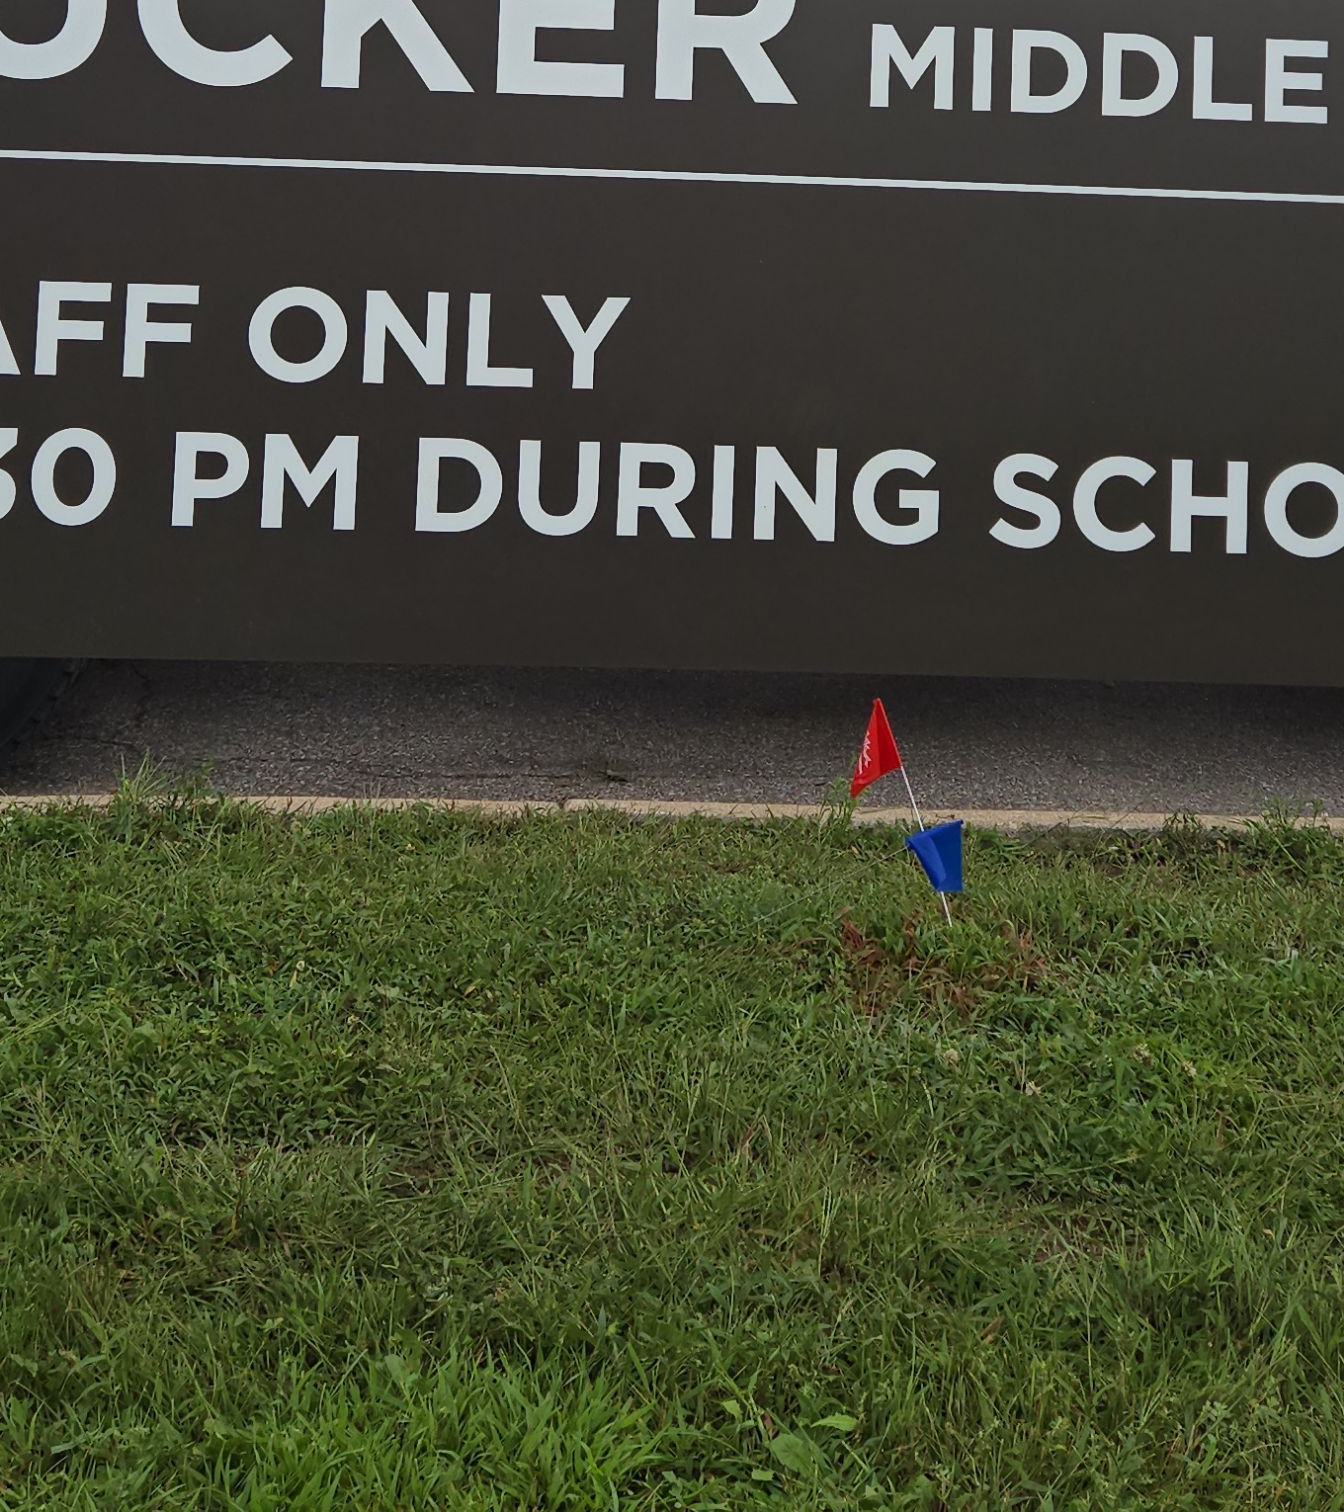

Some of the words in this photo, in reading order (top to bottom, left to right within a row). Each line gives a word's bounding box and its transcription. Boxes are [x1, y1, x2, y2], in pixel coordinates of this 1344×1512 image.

[869, 23, 1330, 125] MIDDLE
[248, 286, 632, 390] ONLY
[171, 431, 359, 531] PM
[414, 437, 940, 545] DURING
